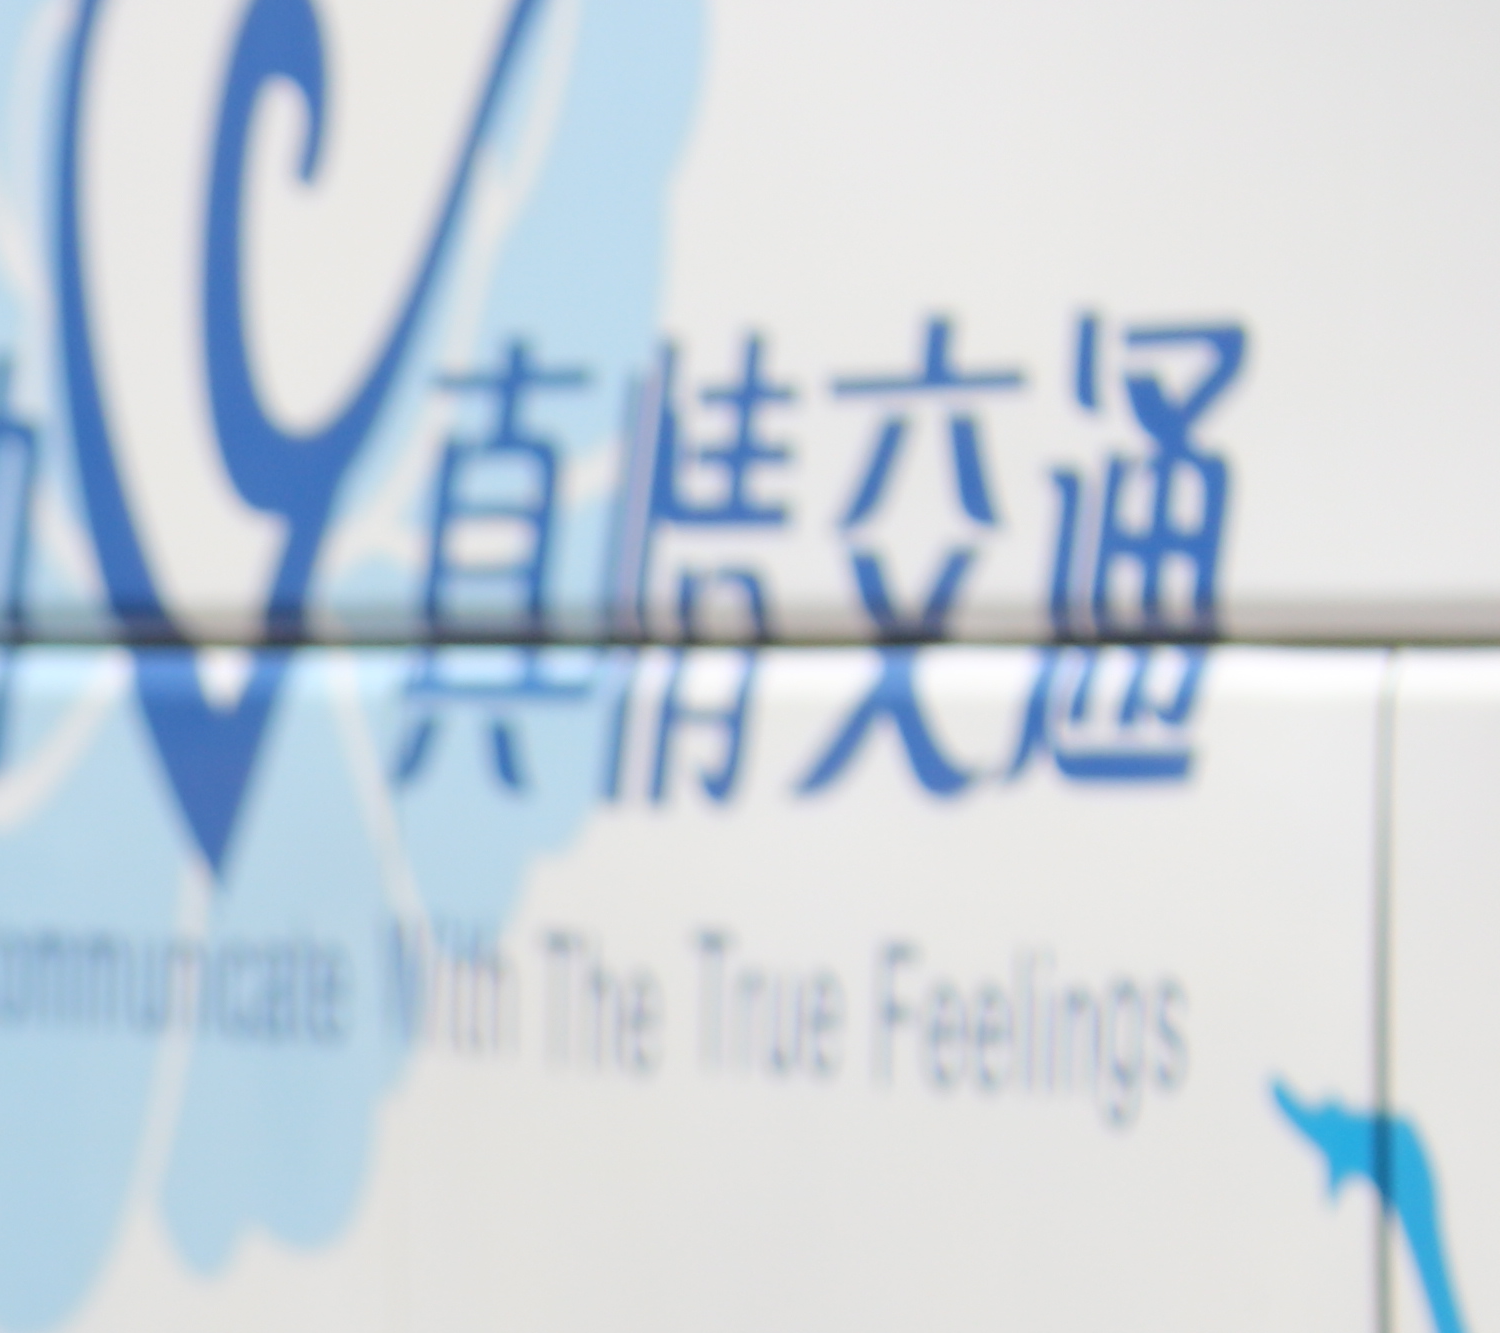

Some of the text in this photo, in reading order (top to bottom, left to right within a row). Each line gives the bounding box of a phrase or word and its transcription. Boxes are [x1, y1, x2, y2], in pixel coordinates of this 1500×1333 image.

[396, 310, 1248, 805] 真情交通
[541, 922, 663, 1080] The
[690, 922, 847, 1082] True
[870, 938, 1194, 1133] Feelings
